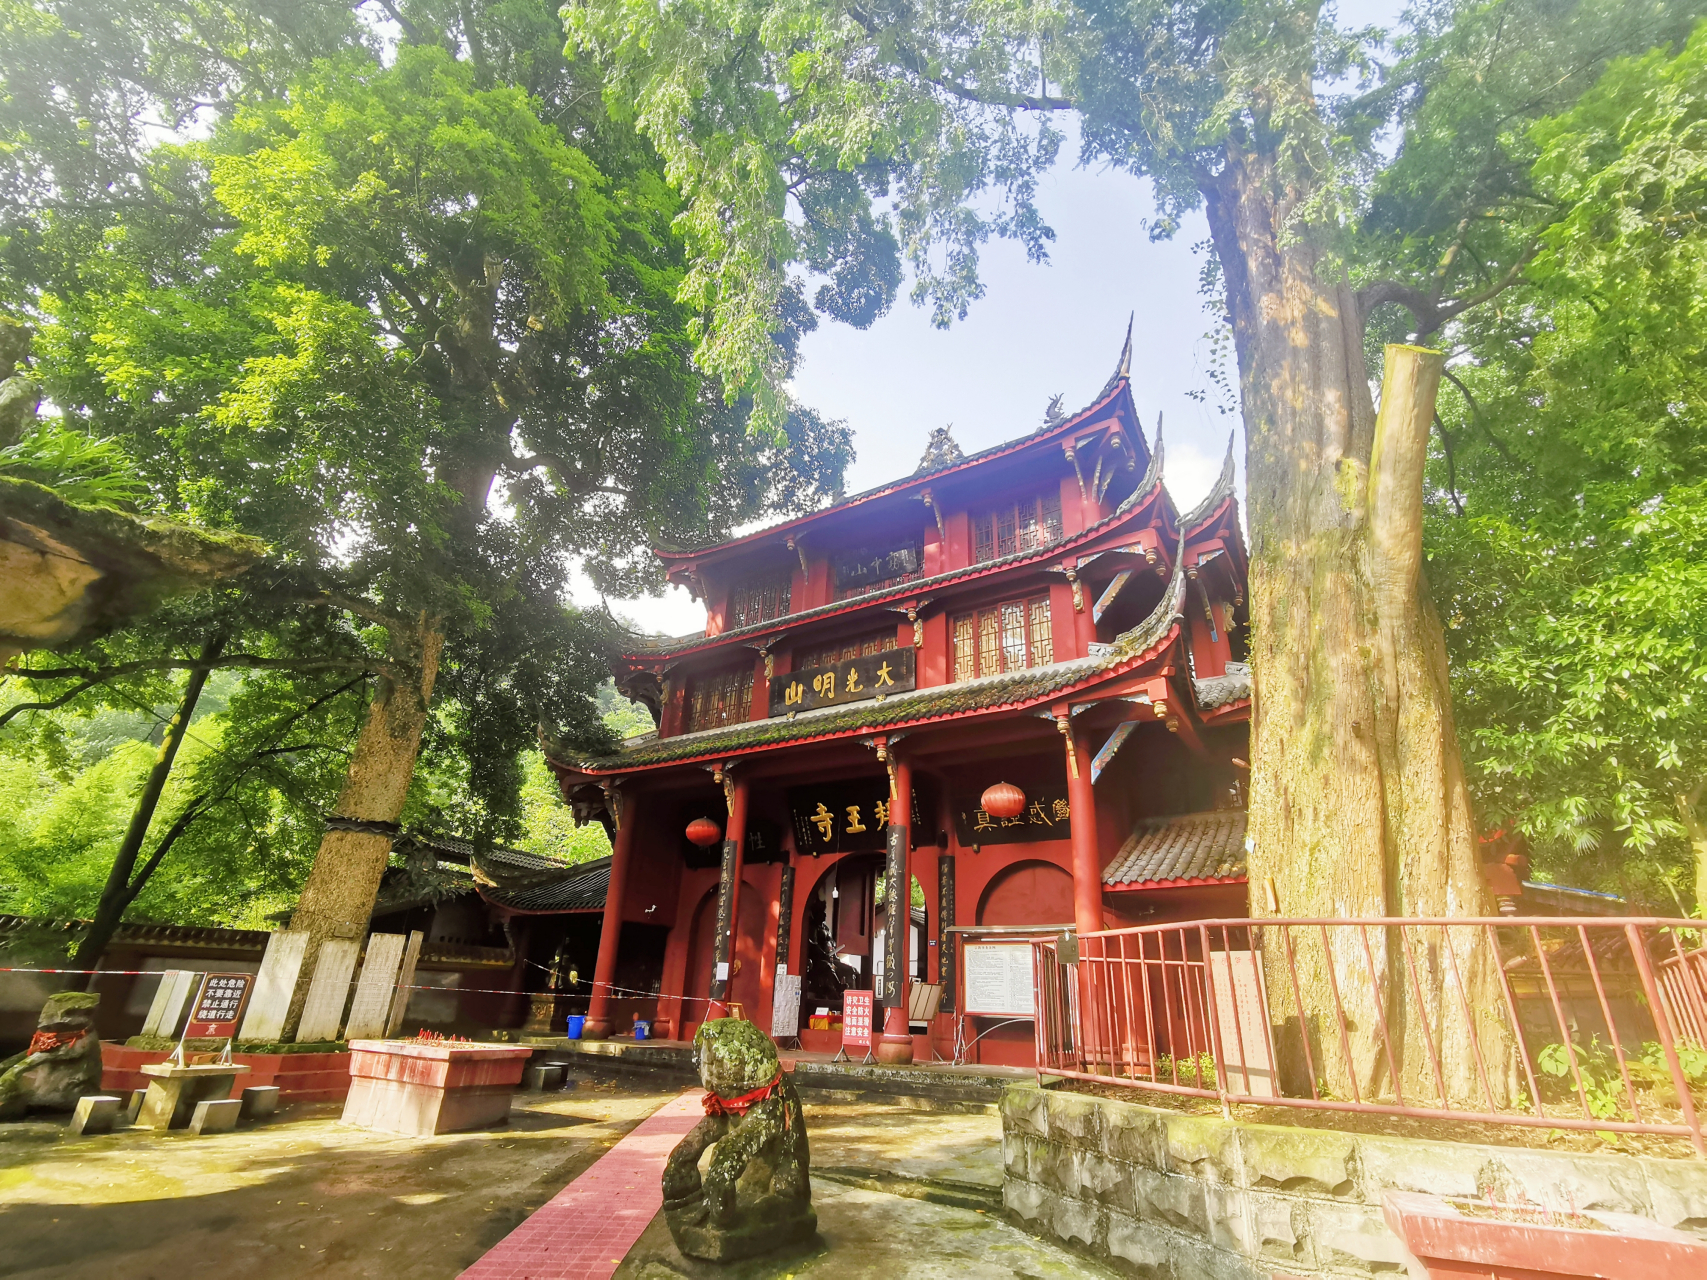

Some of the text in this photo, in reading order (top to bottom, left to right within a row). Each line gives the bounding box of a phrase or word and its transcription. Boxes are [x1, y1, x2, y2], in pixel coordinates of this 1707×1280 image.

[209, 978, 245, 988] 此处危险
[206, 988, 242, 998] 不要靠近
[202, 999, 238, 1009] 禁止通行
[846, 995, 870, 1005] 讲究卫生
[197, 1010, 235, 1019] 绕道行走
[846, 1006, 870, 1016] 安全防火
[845, 1016, 870, 1026] 地面湿滑
[845, 1026, 869, 1037] 注意安全
